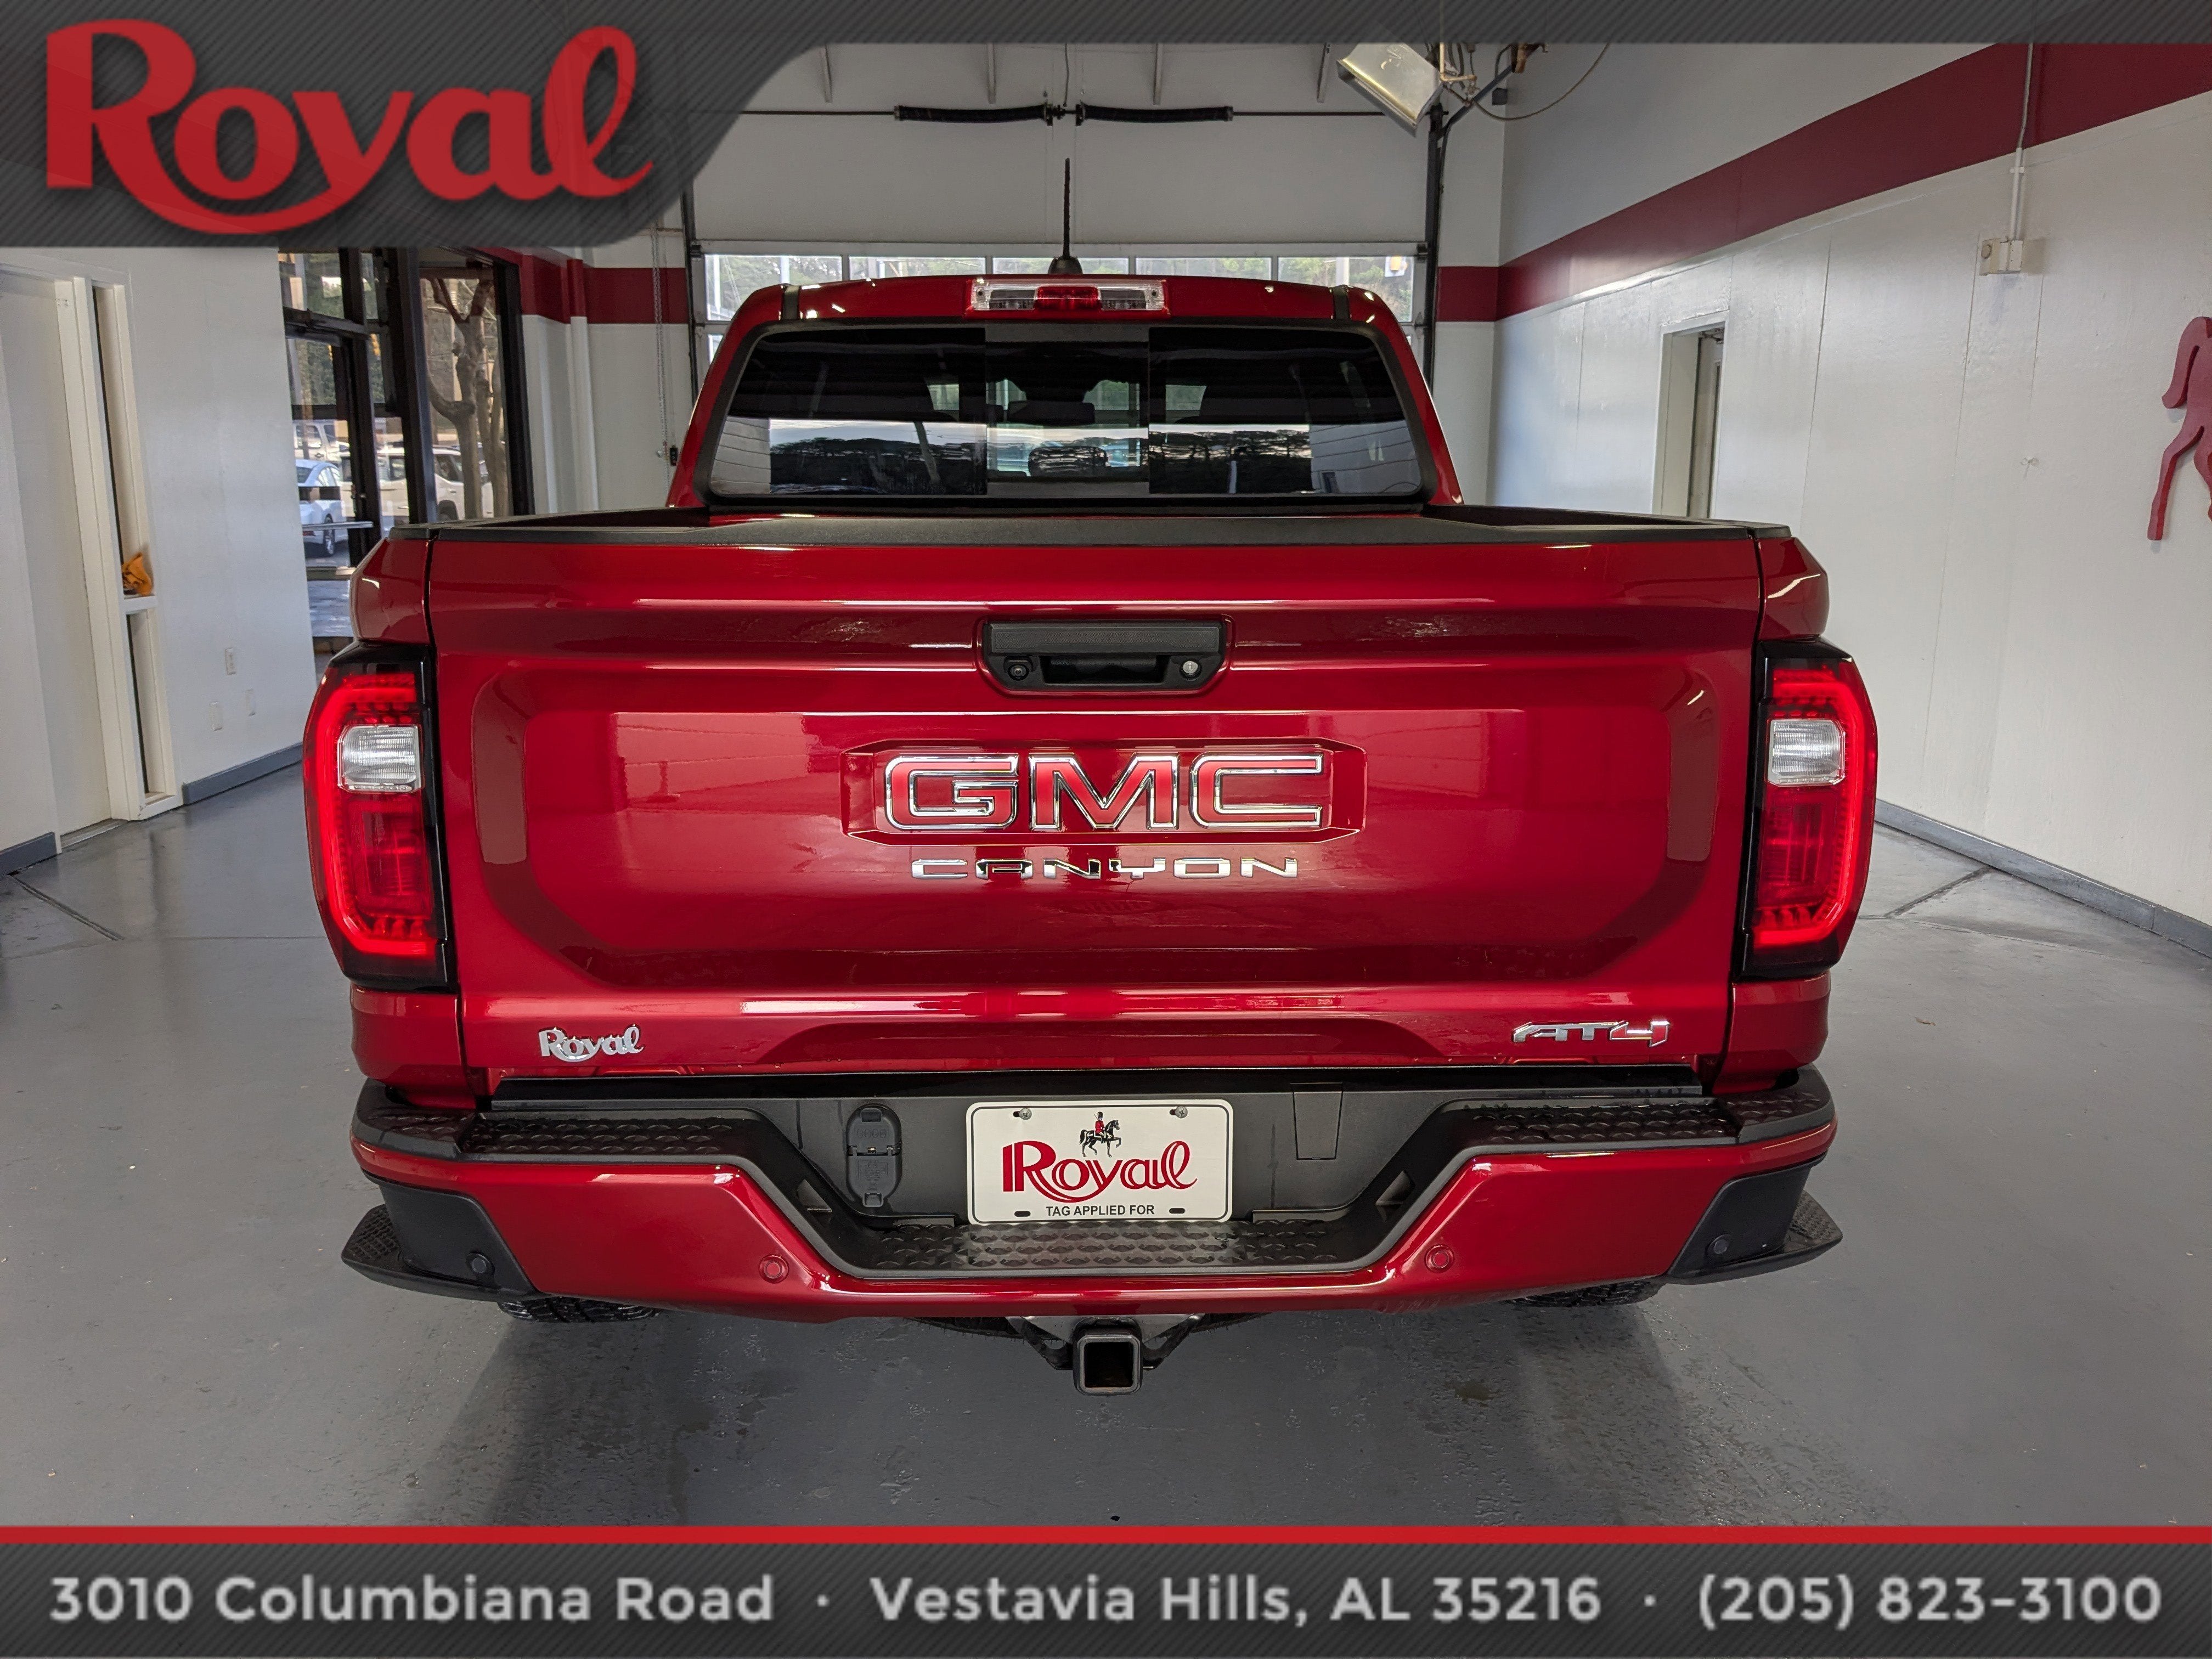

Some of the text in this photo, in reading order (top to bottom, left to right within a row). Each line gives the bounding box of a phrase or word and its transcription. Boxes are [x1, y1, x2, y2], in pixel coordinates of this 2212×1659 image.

[884, 752, 1323, 831] GMC
[911, 857, 1297, 880] CANYON
[538, 1024, 644, 1063] Royal
[1513, 1020, 1670, 1048] AT4
[1002, 1141, 1198, 1203] Royal
[1046, 1205, 1155, 1216] TAG APPLIED FOR
